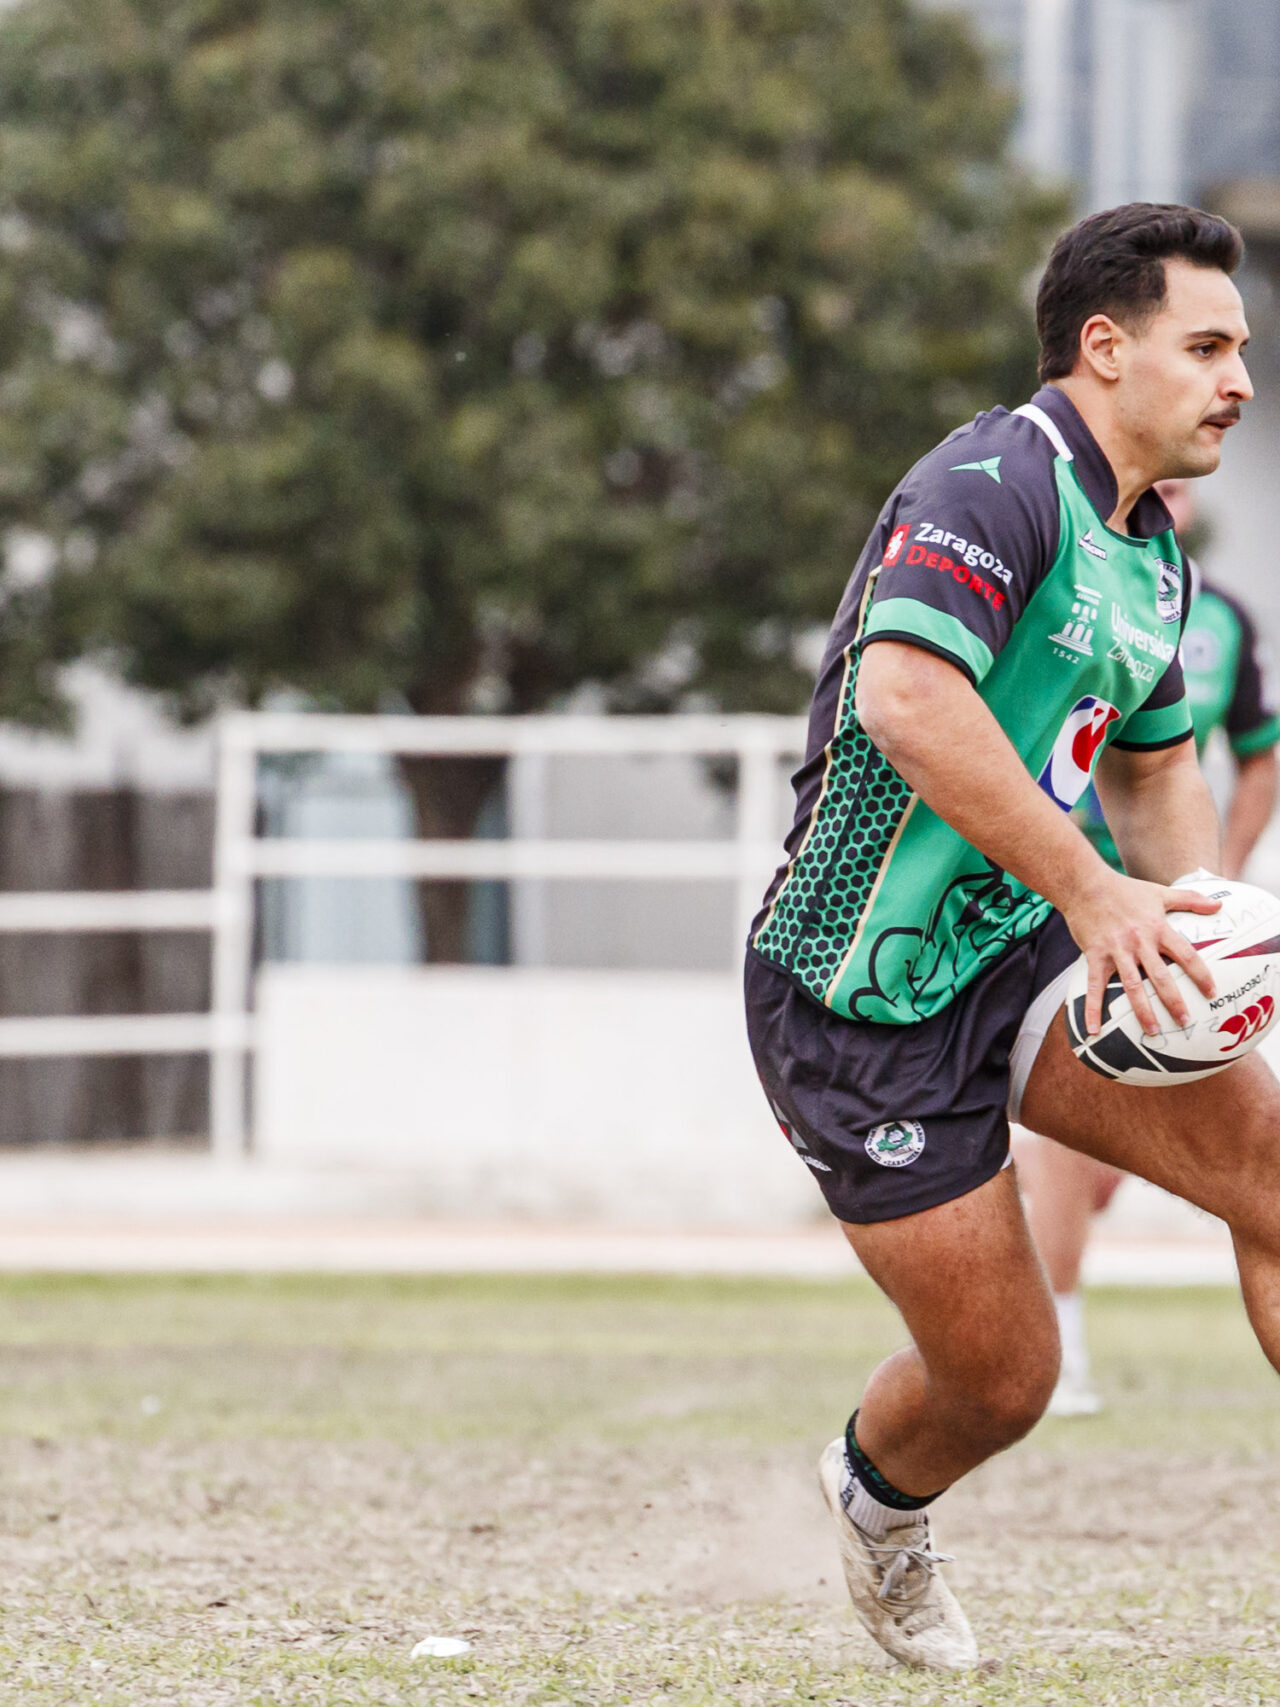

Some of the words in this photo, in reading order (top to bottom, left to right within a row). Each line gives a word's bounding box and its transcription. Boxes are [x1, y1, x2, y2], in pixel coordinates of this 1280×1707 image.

[905, 545, 1007, 611] DEPORTE
[914, 522, 1014, 586] Zaragoza
[1052, 646, 1080, 665] 1542
[1107, 635, 1156, 683] Zaragoza
